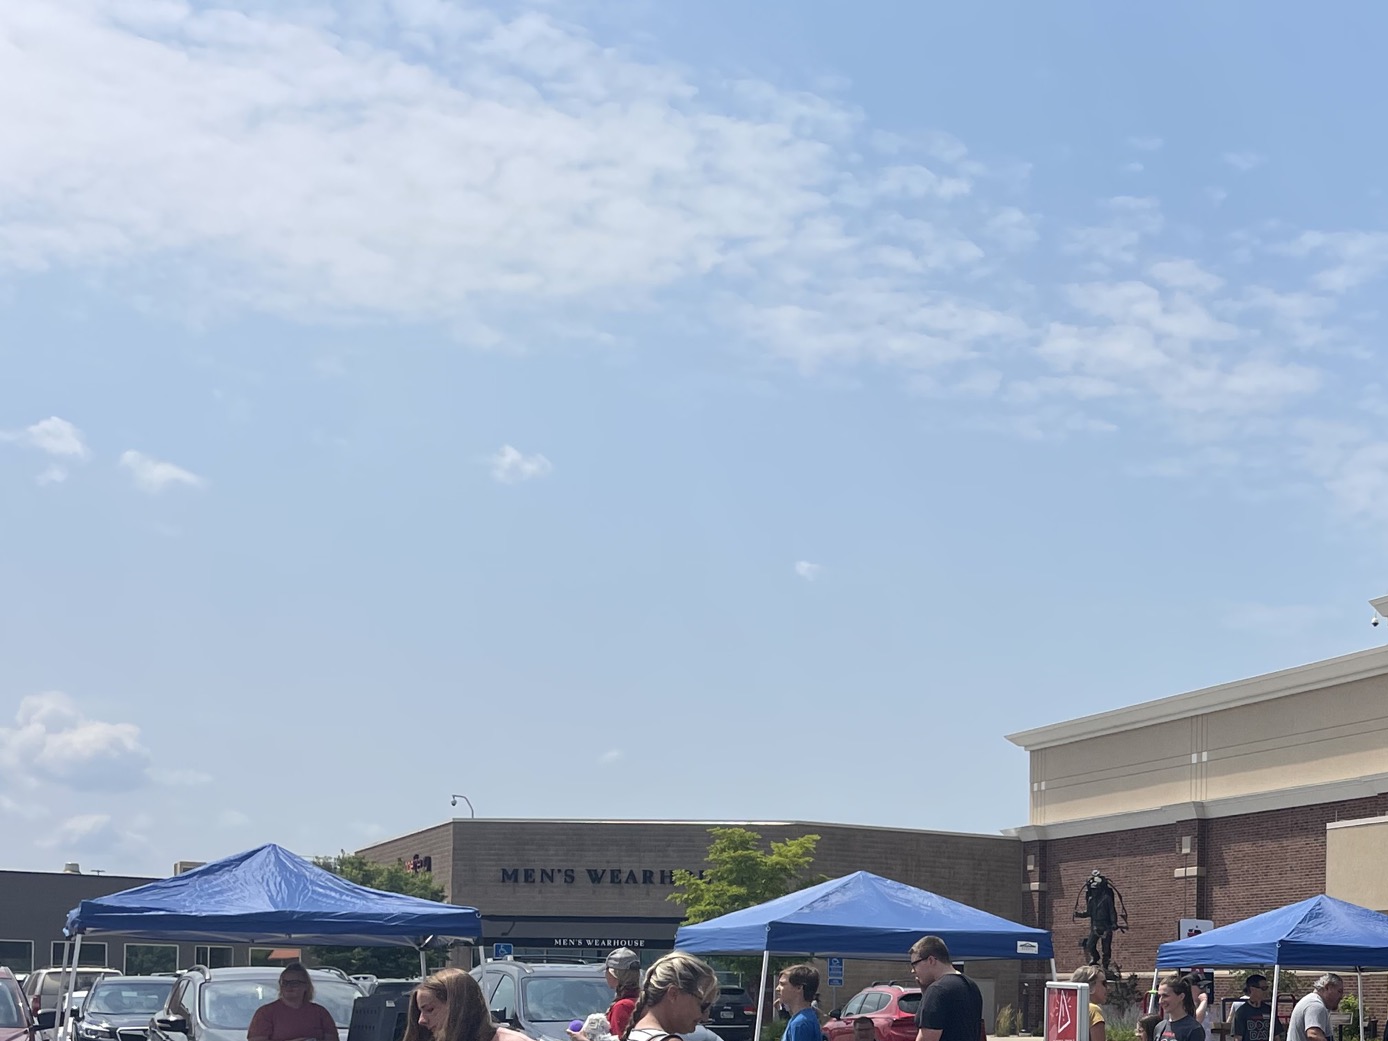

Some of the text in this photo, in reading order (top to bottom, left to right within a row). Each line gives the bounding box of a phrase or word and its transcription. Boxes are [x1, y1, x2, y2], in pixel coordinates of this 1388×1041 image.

[501, 868, 575, 884] MEN'S
[554, 938, 645, 947] MEN'S WEARHOUSE
